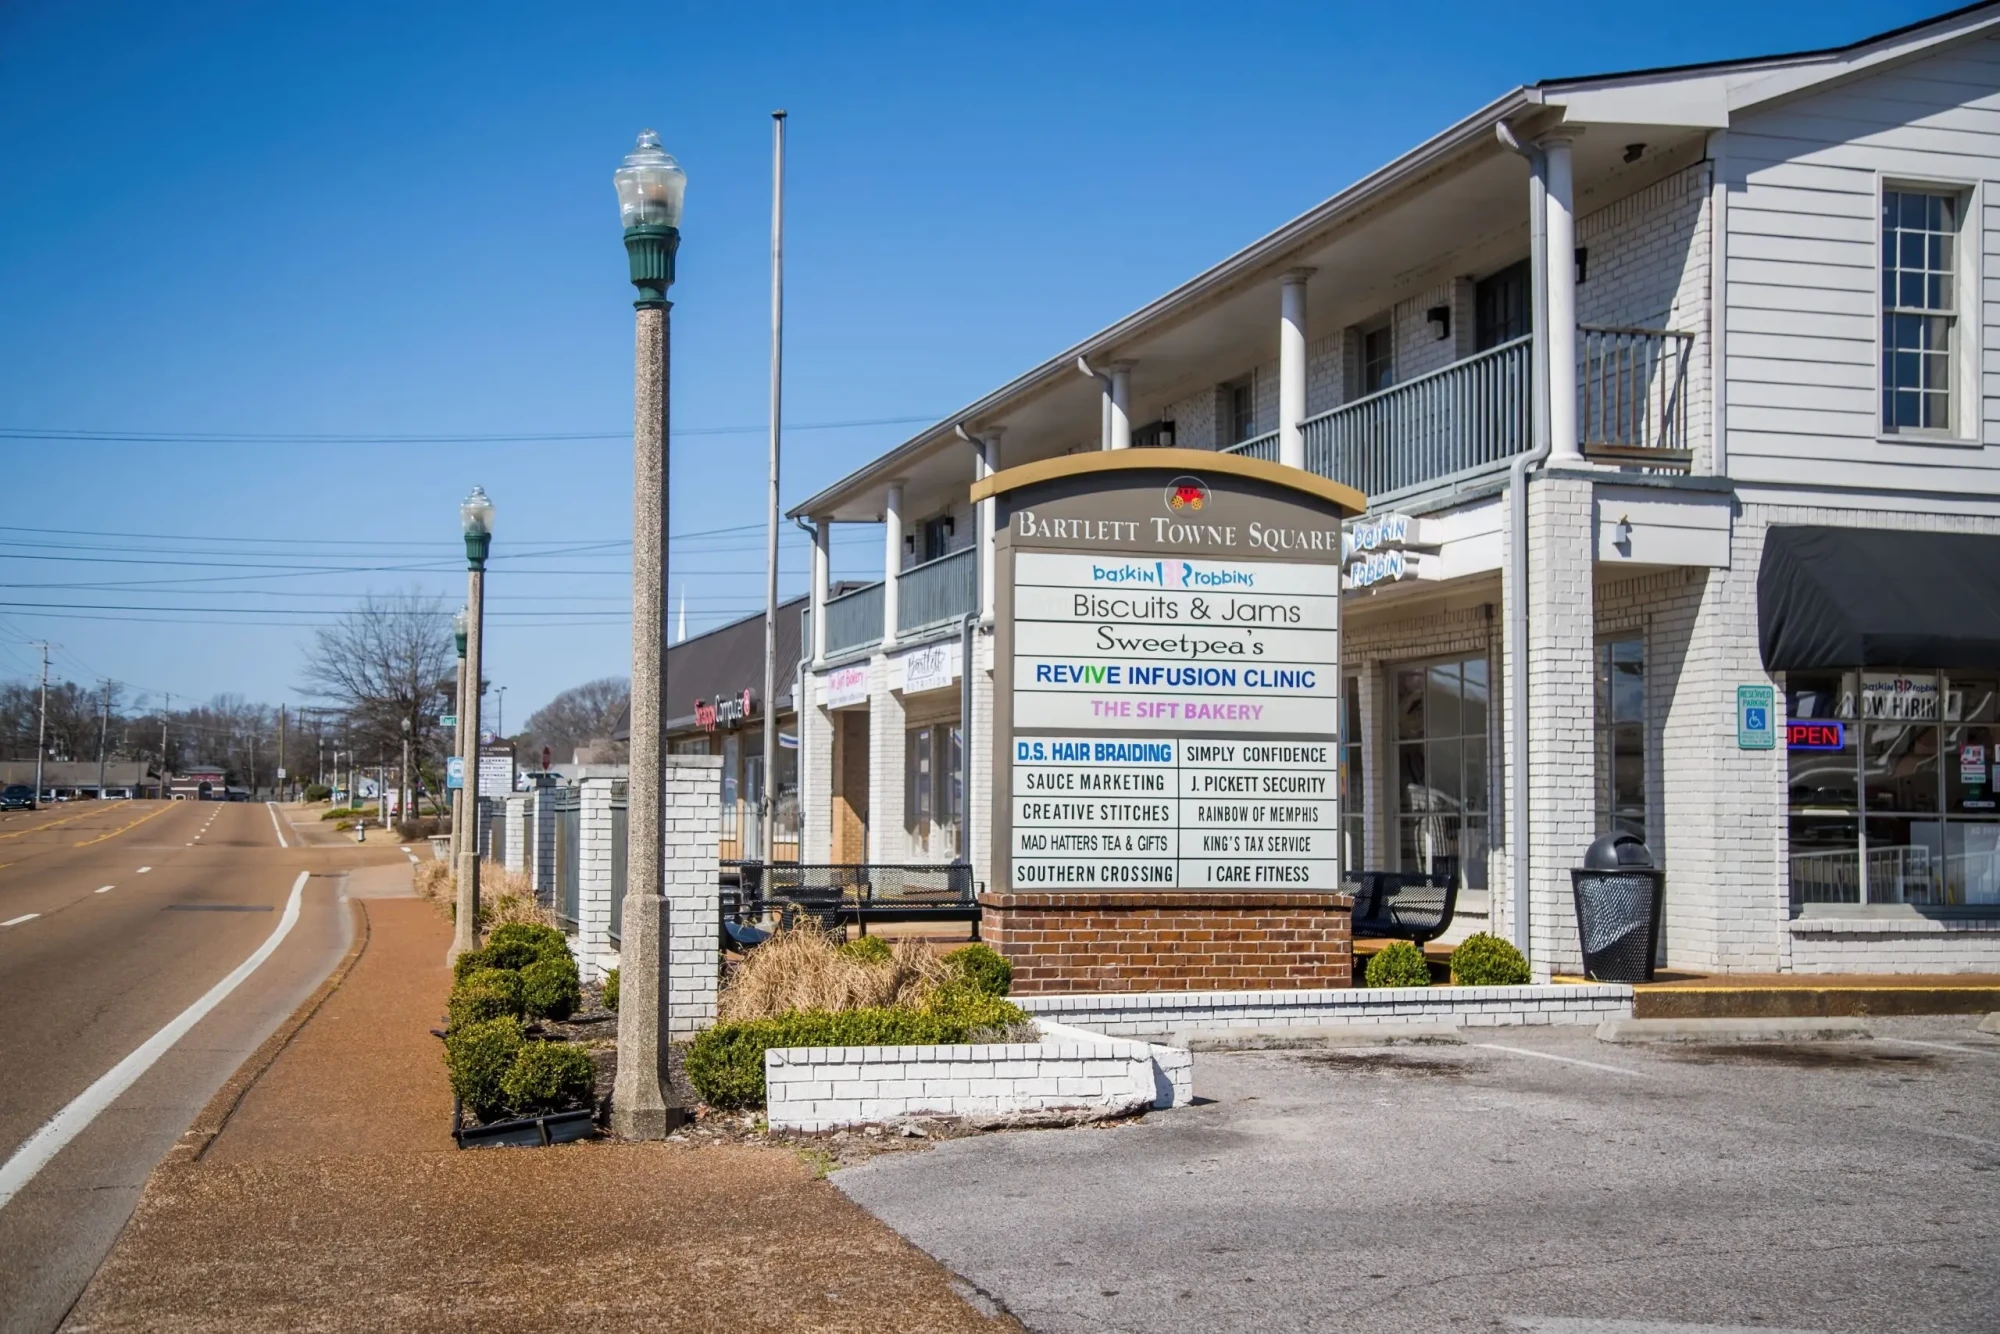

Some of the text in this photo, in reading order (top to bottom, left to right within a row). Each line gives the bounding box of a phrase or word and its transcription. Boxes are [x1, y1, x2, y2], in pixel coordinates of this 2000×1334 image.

[1019, 511, 1337, 552] BARTLETT TOWNE SQUARE
[1074, 593, 1302, 623] Biscuits & Jams
[1096, 625, 1264, 659] Sweetpea's
[1036, 663, 1316, 689] REVIVE INFUSION CLINIC
[1740, 690, 1771, 698] RESERVED
[1091, 700, 1264, 721] THE SIFT BAKERY
[1743, 699, 1769, 708] PARKING
[1787, 726, 1838, 745] PEN
[1017, 742, 1172, 763] D.S. HAIR BRAIDING
[1187, 746, 1327, 764] SIMPLY CONFIDENCE
[1026, 773, 1165, 791] SAUCE MARKETING
[1191, 776, 1326, 793] J. PICKETT SECURITY
[1022, 803, 1170, 822] CREATIVE STITCHES
[1198, 806, 1319, 823] RAINBOW OF MEMPHIS
[1021, 834, 1168, 852] MAD HATTERS TEA & GIFTS
[1203, 835, 1311, 853] KING'S TAX SERVICE
[1017, 864, 1173, 883] SOUTHERN CROSSING
[1207, 866, 1310, 883] I CARE FITNESS
